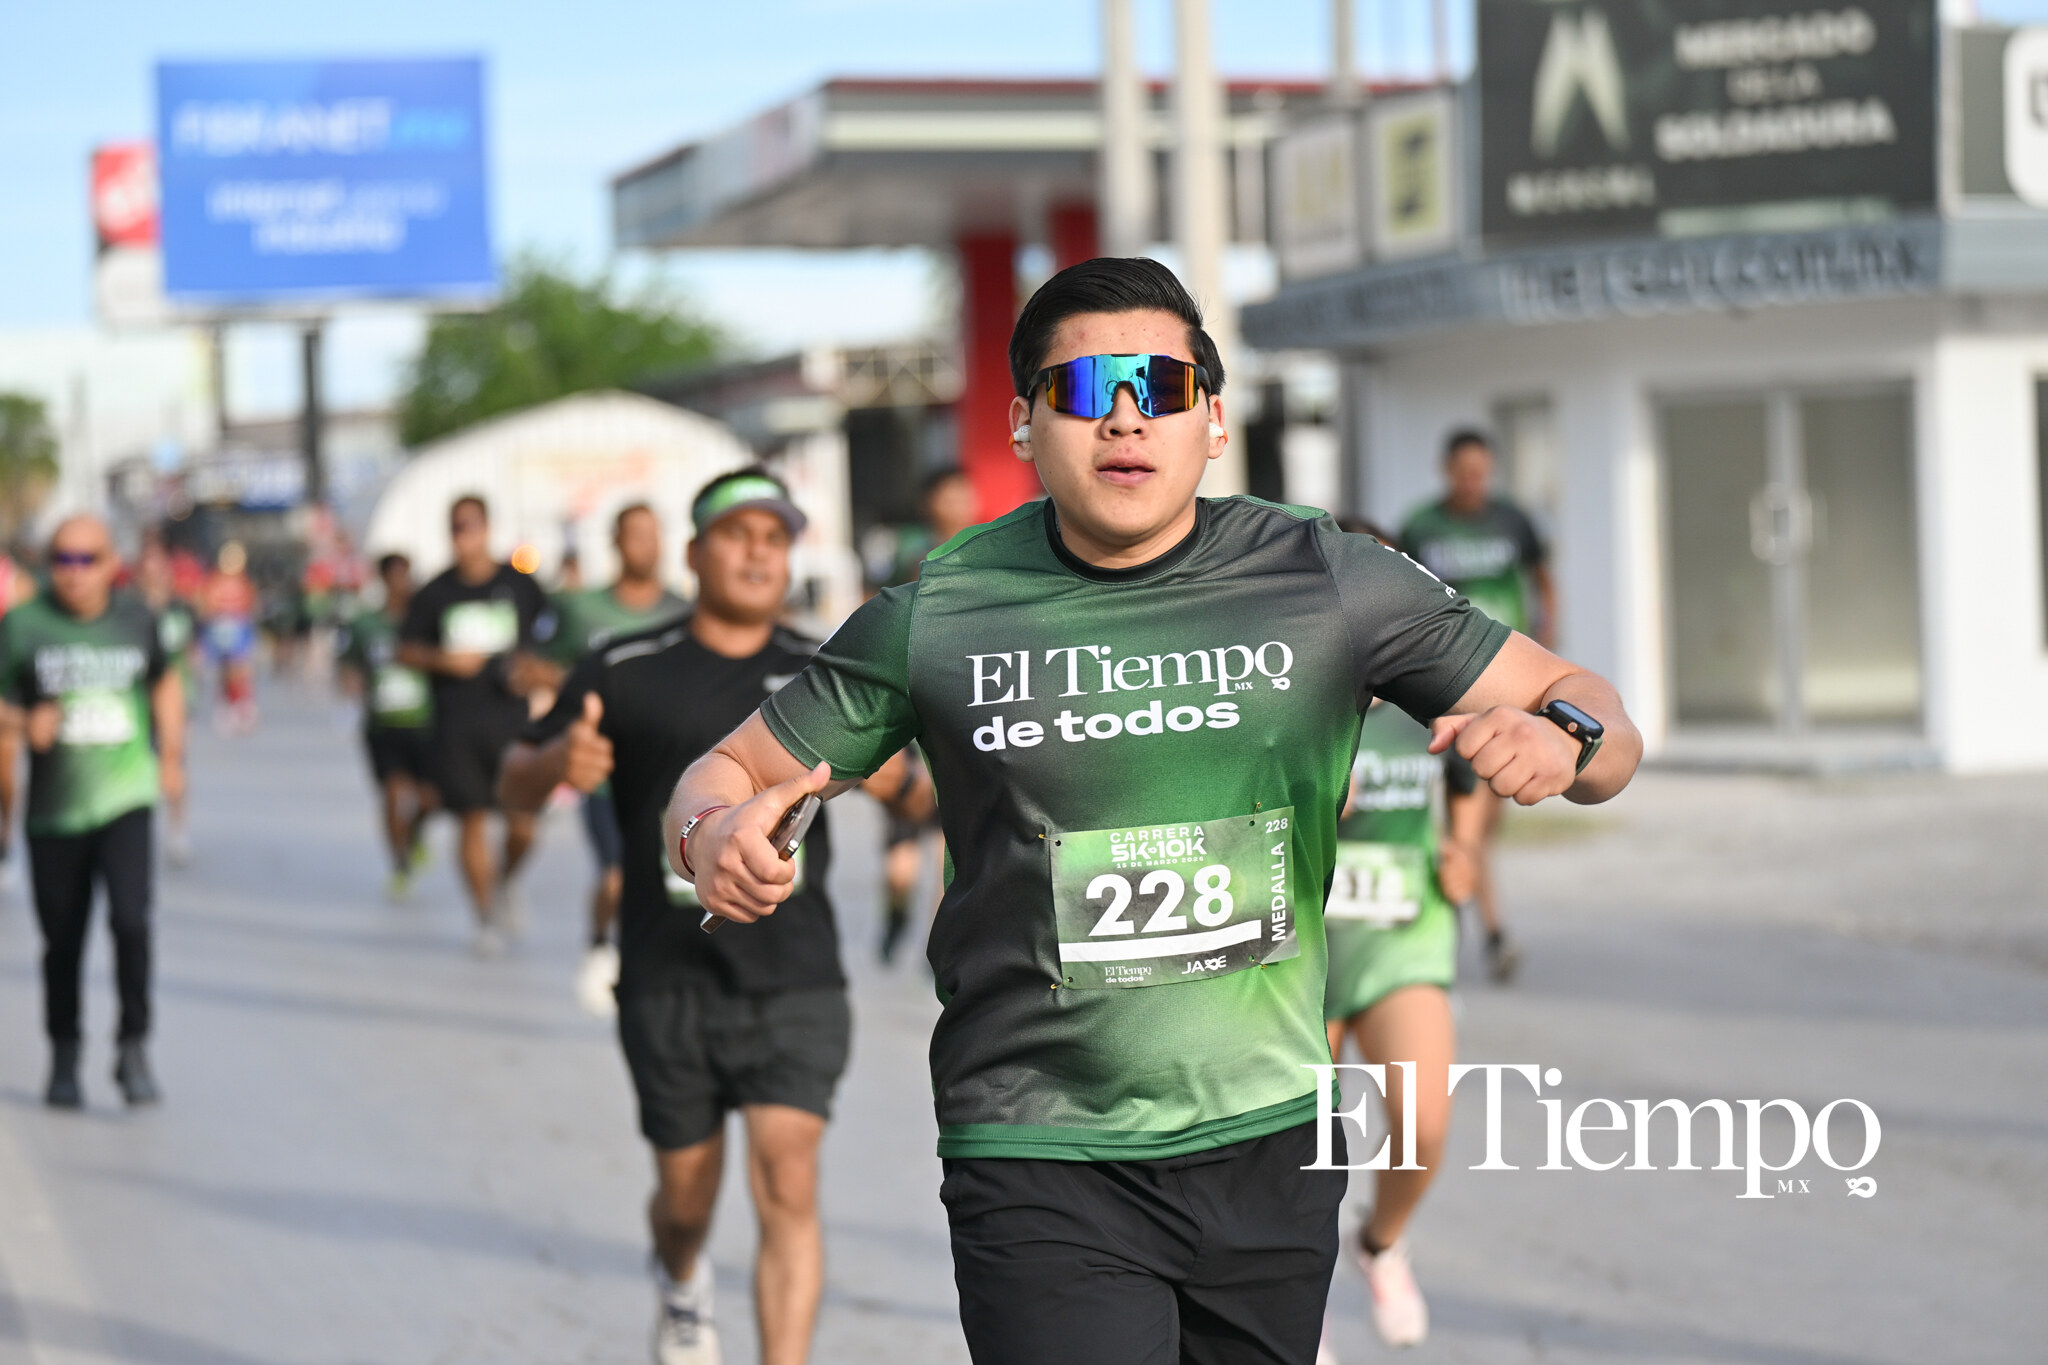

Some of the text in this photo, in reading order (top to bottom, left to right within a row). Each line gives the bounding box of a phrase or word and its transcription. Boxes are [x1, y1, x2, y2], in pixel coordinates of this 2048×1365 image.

[1674, 9, 1875, 69] MERCADO
[1655, 98, 1896, 161] SOLDADURA
[966, 641, 1294, 707] El Tiempo
[1234, 681, 1254, 692] MX
[972, 700, 1241, 752] de todos
[1109, 825, 1205, 844] CARRERA
[1265, 817, 1289, 834] 228
[1146, 858, 1178, 867] MARZO
[1085, 864, 1234, 937] 228
[1271, 841, 1286, 942] MEDALLA
[1105, 965, 1152, 976] El Tiempo
[1118, 975, 1144, 983] todos
